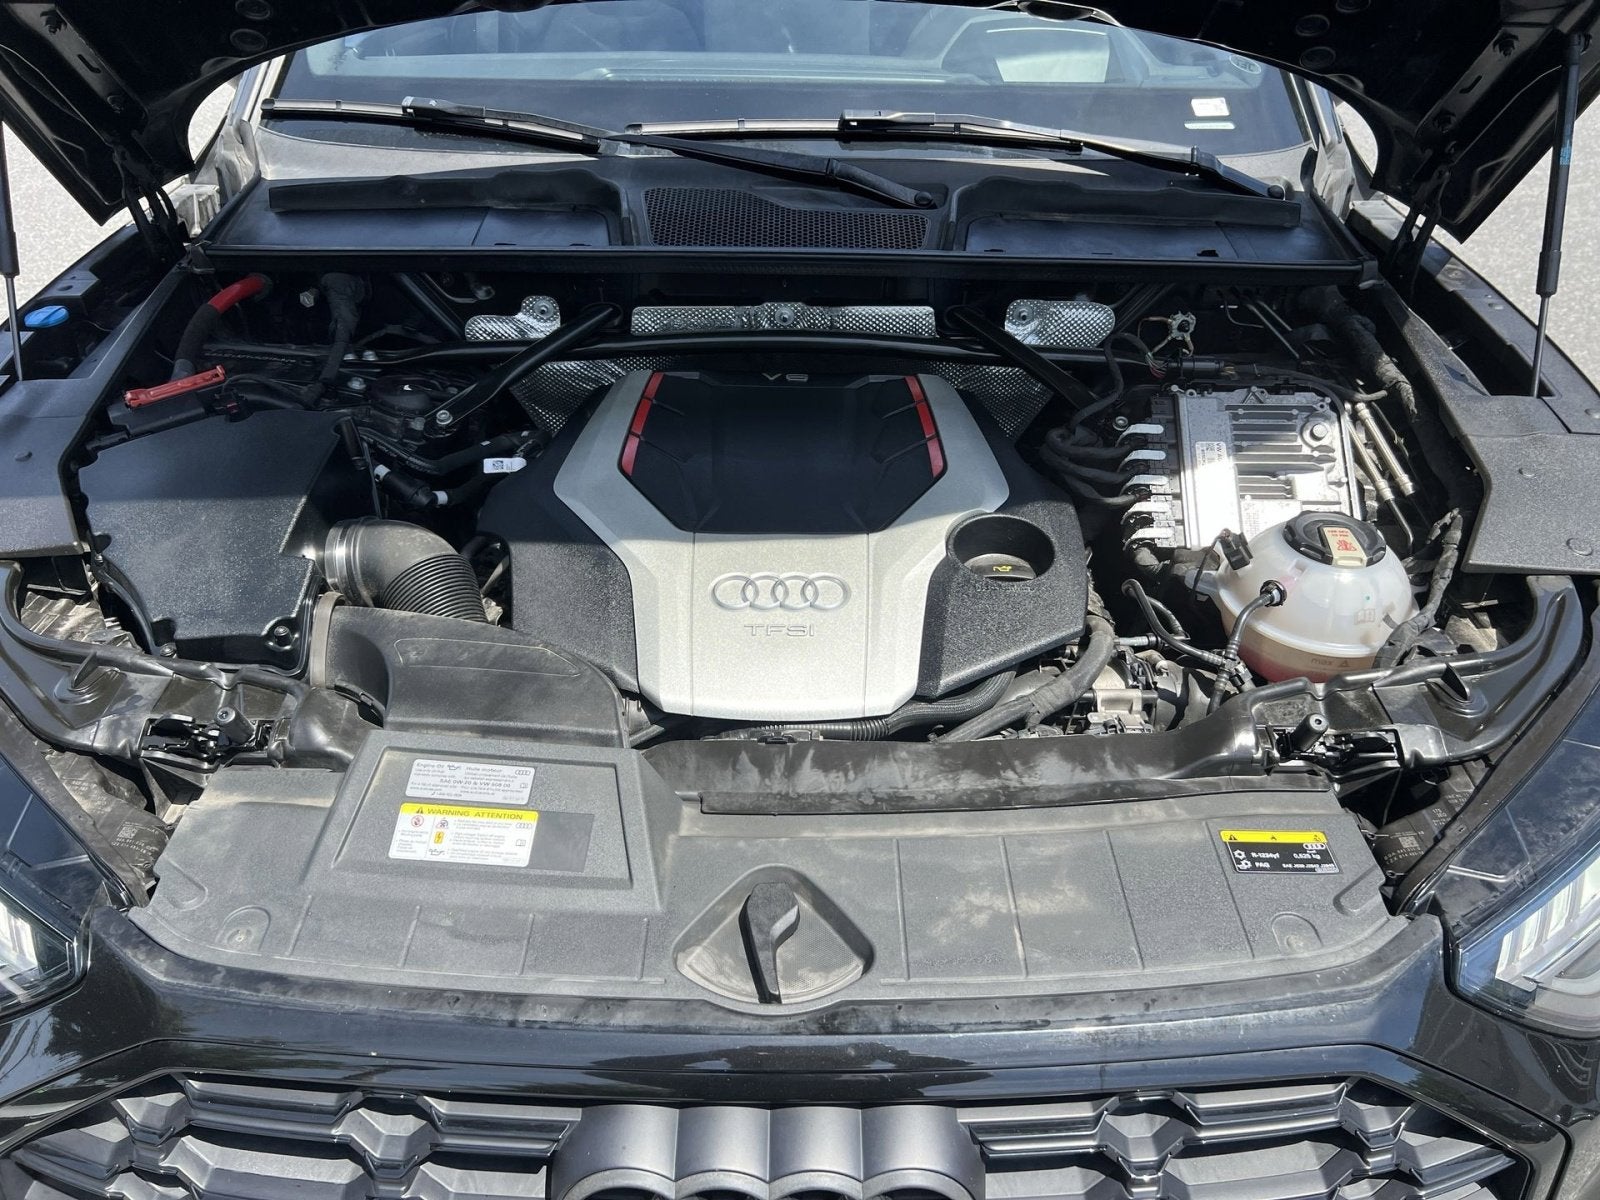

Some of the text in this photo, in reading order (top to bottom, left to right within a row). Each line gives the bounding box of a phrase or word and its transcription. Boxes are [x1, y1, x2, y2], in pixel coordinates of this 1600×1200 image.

[743, 623, 815, 637] TFSI
[427, 807, 523, 821] WARNING ATTENTION
[1254, 861, 1271, 869] PAG
